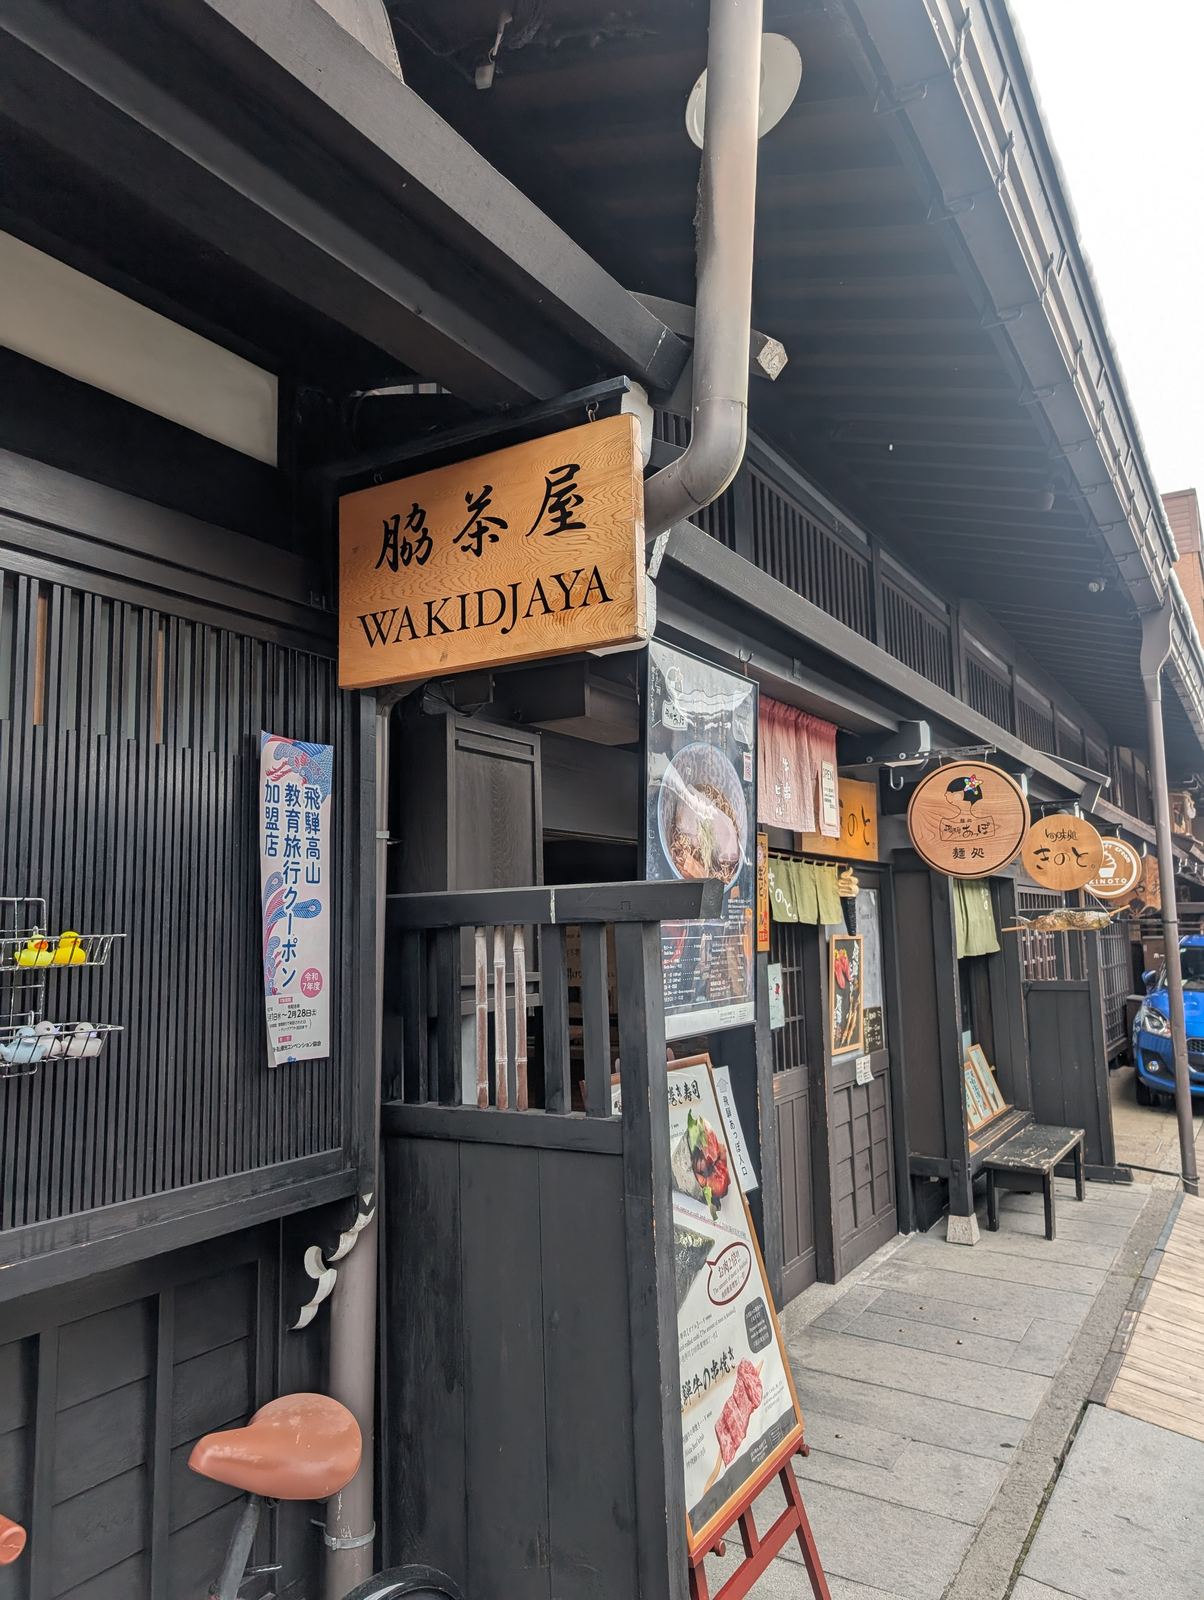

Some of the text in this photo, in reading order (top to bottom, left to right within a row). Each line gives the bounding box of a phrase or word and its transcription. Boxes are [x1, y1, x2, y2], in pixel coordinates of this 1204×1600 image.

[374, 463, 587, 573] 脇茶屋
[357, 564, 613, 648] WAKIDJAYA
[264, 779, 280, 858] 加盟店
[304, 786, 321, 885] 飛騨高山
[282, 782, 302, 988] 教育旅行クーポン
[302, 981, 321, 992] 7年度
[304, 972, 319, 981] 令和
